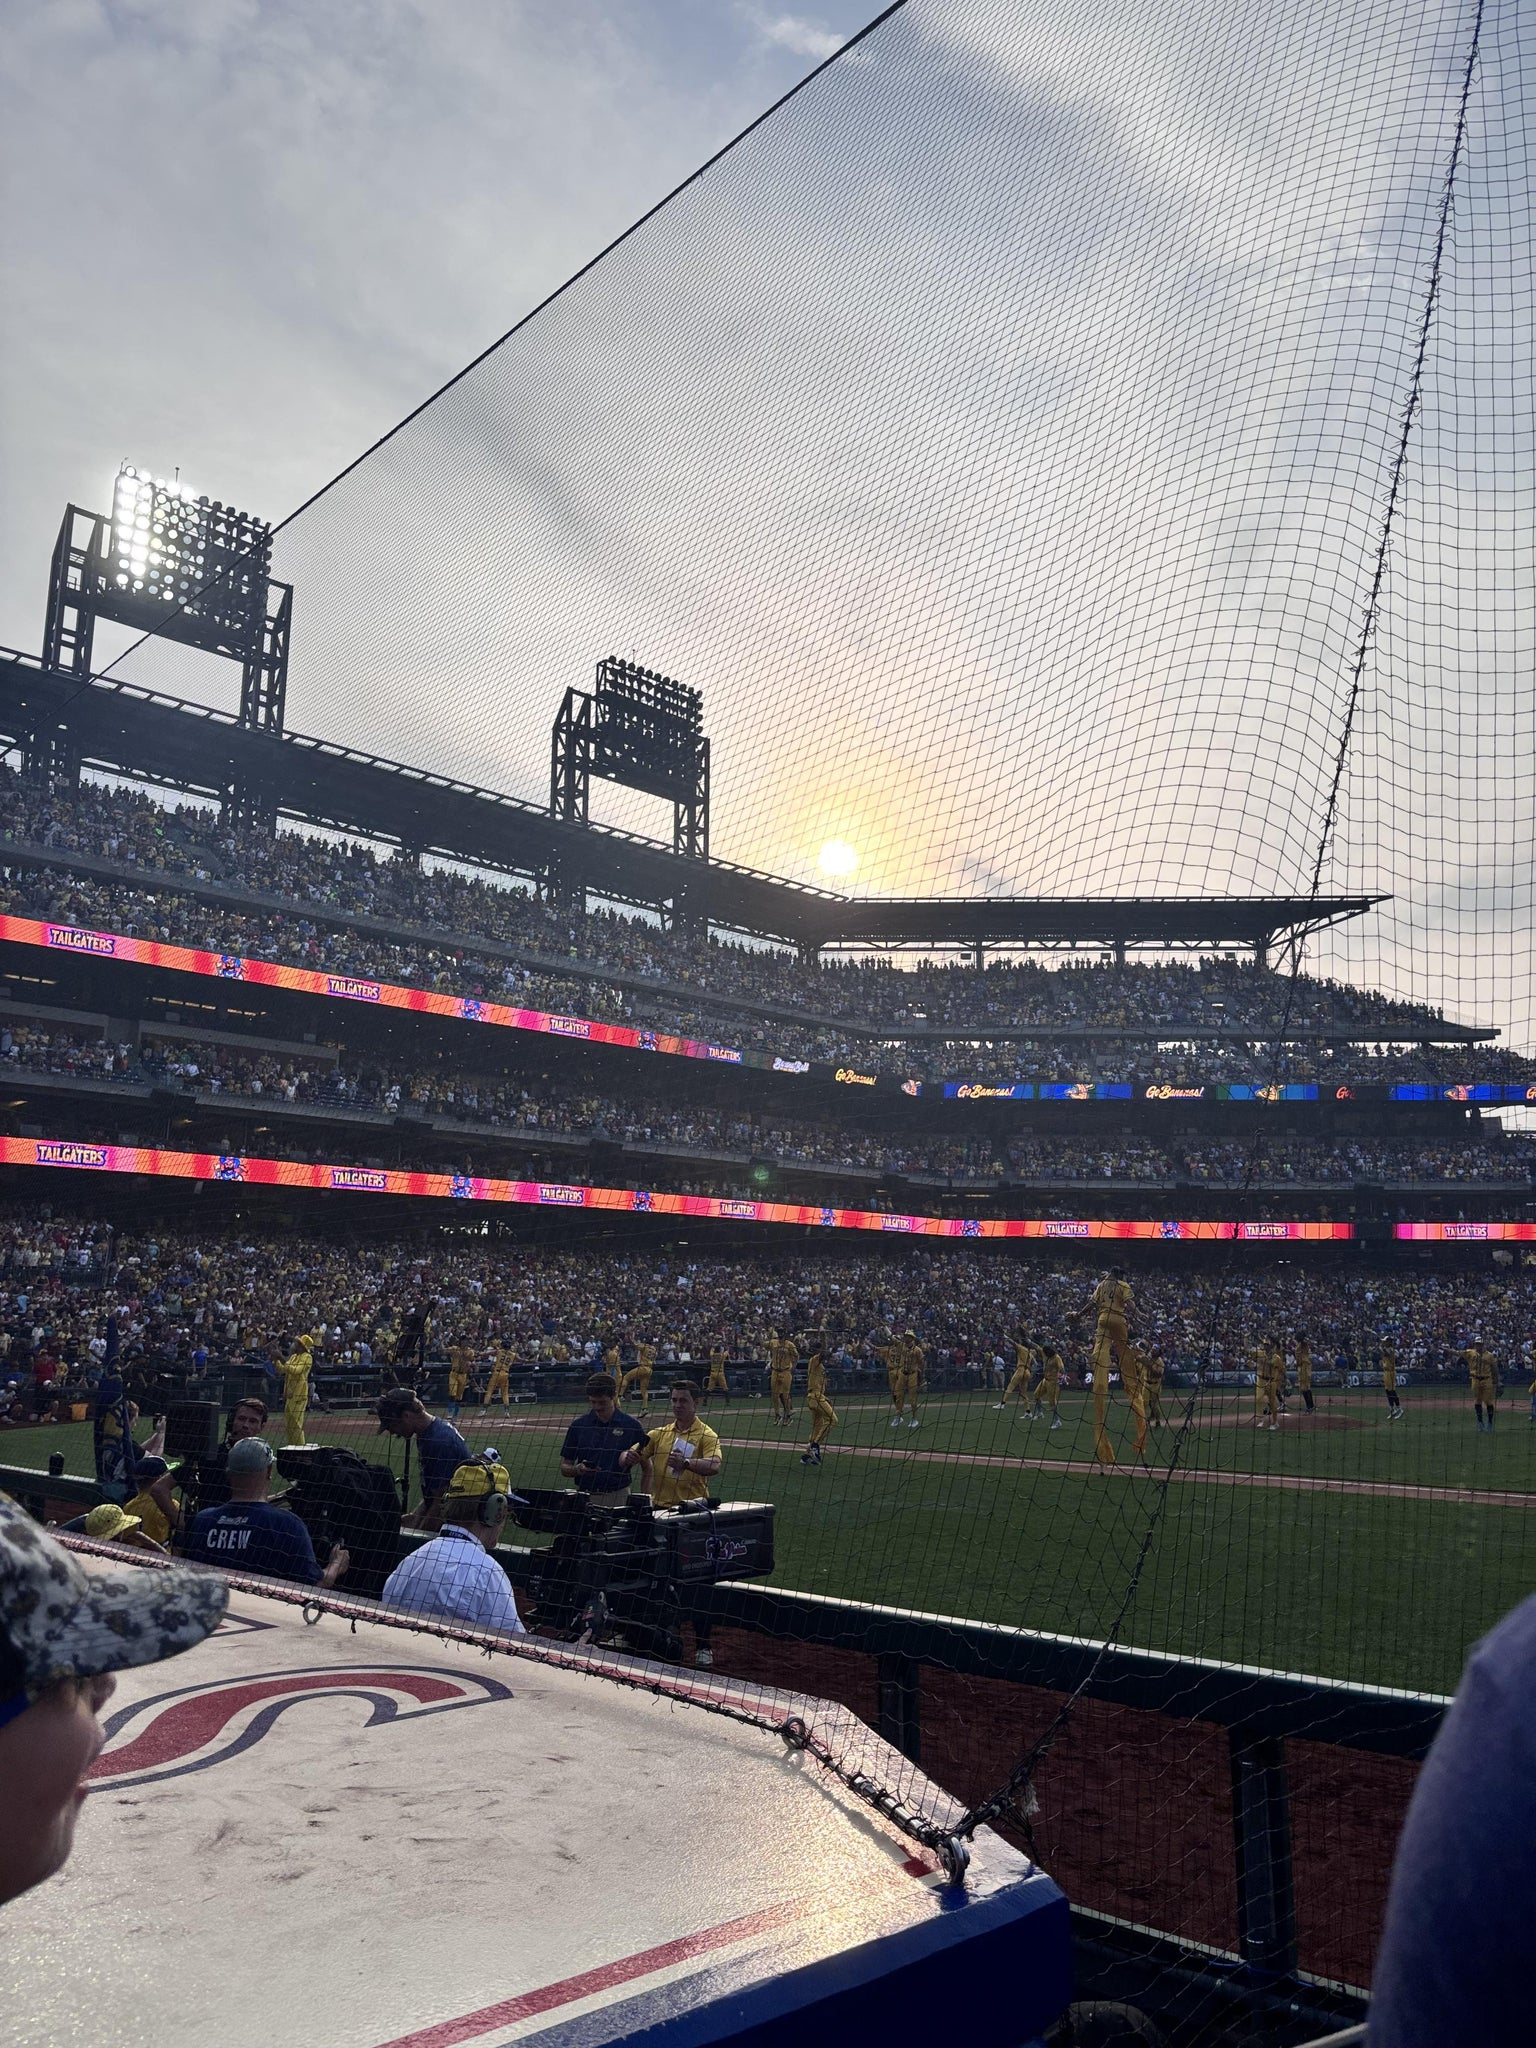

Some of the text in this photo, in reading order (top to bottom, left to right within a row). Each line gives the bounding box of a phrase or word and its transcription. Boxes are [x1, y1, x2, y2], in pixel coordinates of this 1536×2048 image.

[51, 929, 113, 953] TAILGATERS
[329, 979, 379, 999] TAILGATERS
[550, 1019, 589, 1036] TAILGATERS
[708, 1046, 741, 1062] TAILGATERS
[38, 1145, 104, 1164] TAILGATERS
[333, 1171, 385, 1188] TAILGATERS
[541, 1188, 583, 1202] TAILGATERS
[721, 1203, 755, 1216] TAILGATERS
[1046, 1224, 1087, 1235] TAILGATERS
[1246, 1226, 1287, 1237] TAILGATERS
[1446, 1226, 1487, 1237] TAILGATERS
[206, 1528, 252, 1550] CREW
